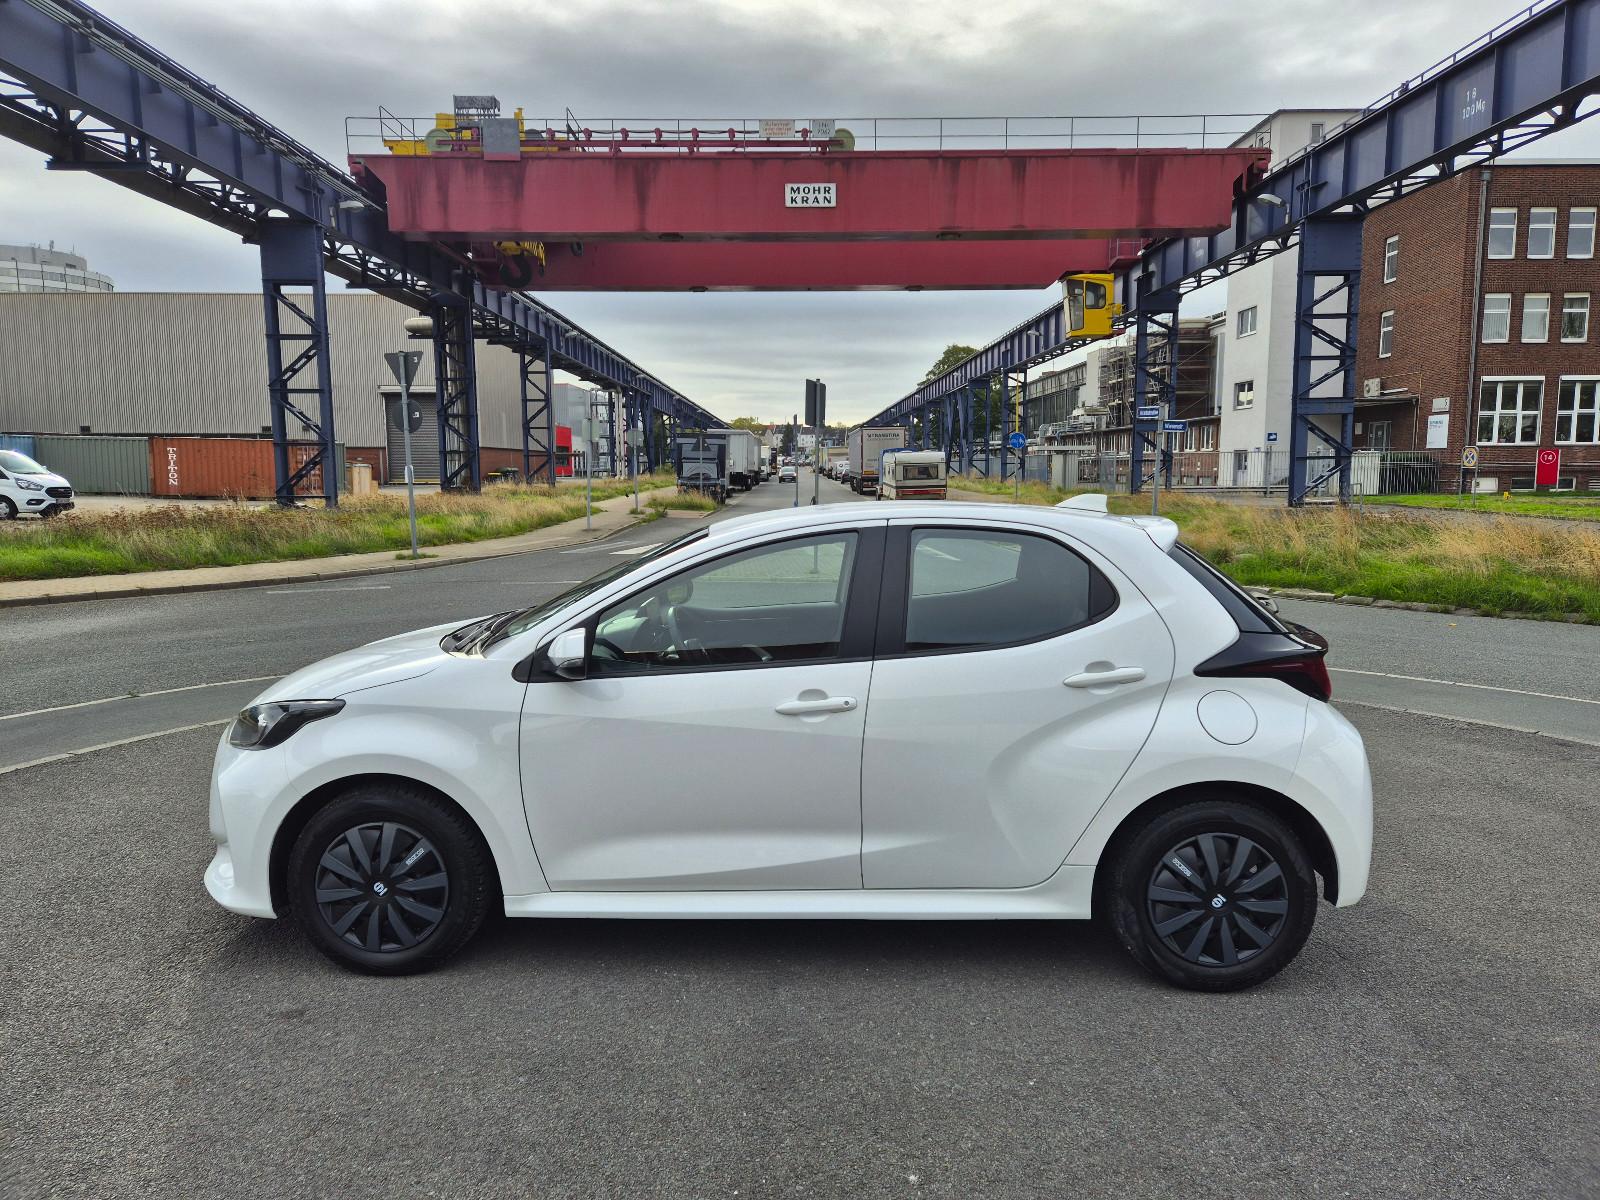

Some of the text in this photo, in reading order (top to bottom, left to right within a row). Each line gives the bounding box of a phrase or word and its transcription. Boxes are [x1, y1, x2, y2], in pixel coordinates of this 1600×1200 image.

[790, 186, 831, 195] MOHR
[790, 195, 831, 205] KRAN
[167, 447, 178, 486] TRITON
